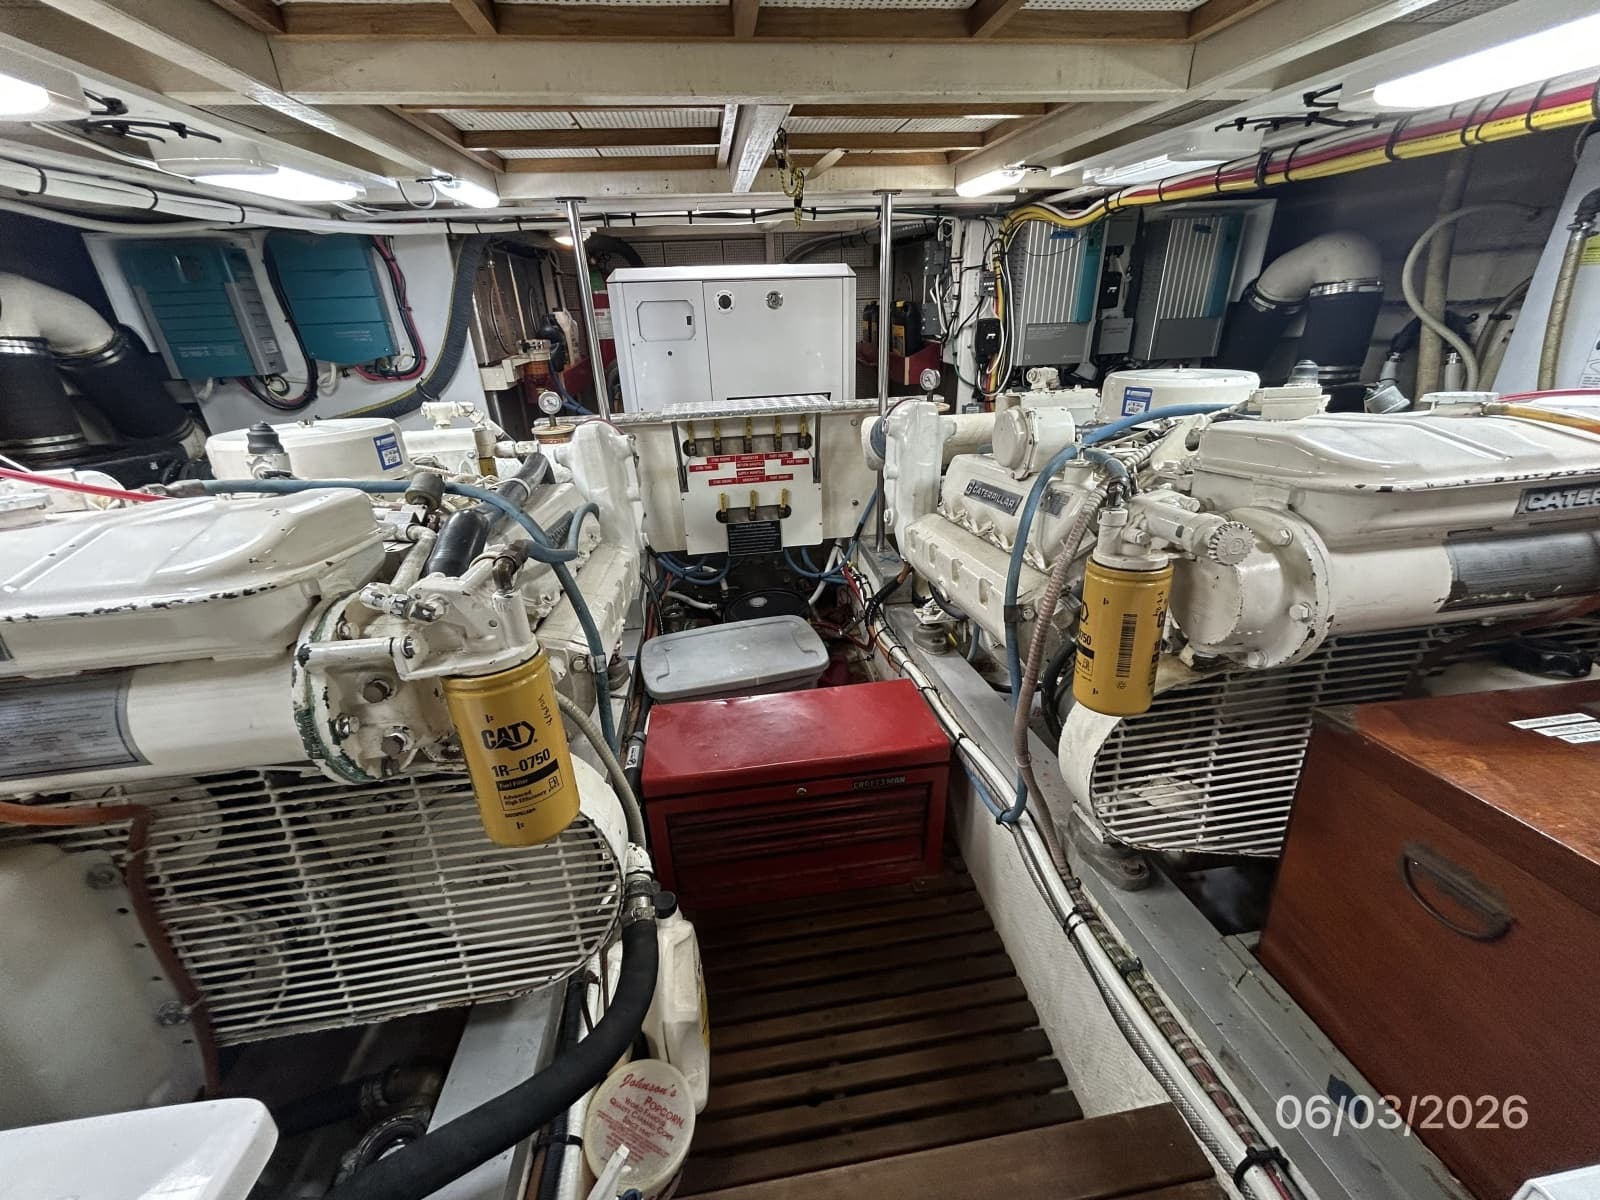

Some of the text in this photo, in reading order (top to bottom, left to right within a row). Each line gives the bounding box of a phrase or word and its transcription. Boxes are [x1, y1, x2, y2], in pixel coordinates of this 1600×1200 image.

[972, 485, 1017, 509] CATERPILLAR
[481, 721, 528, 751] CAT
[619, 1073, 678, 1098] Johnson's
[643, 1095, 685, 1129] POPCORN
